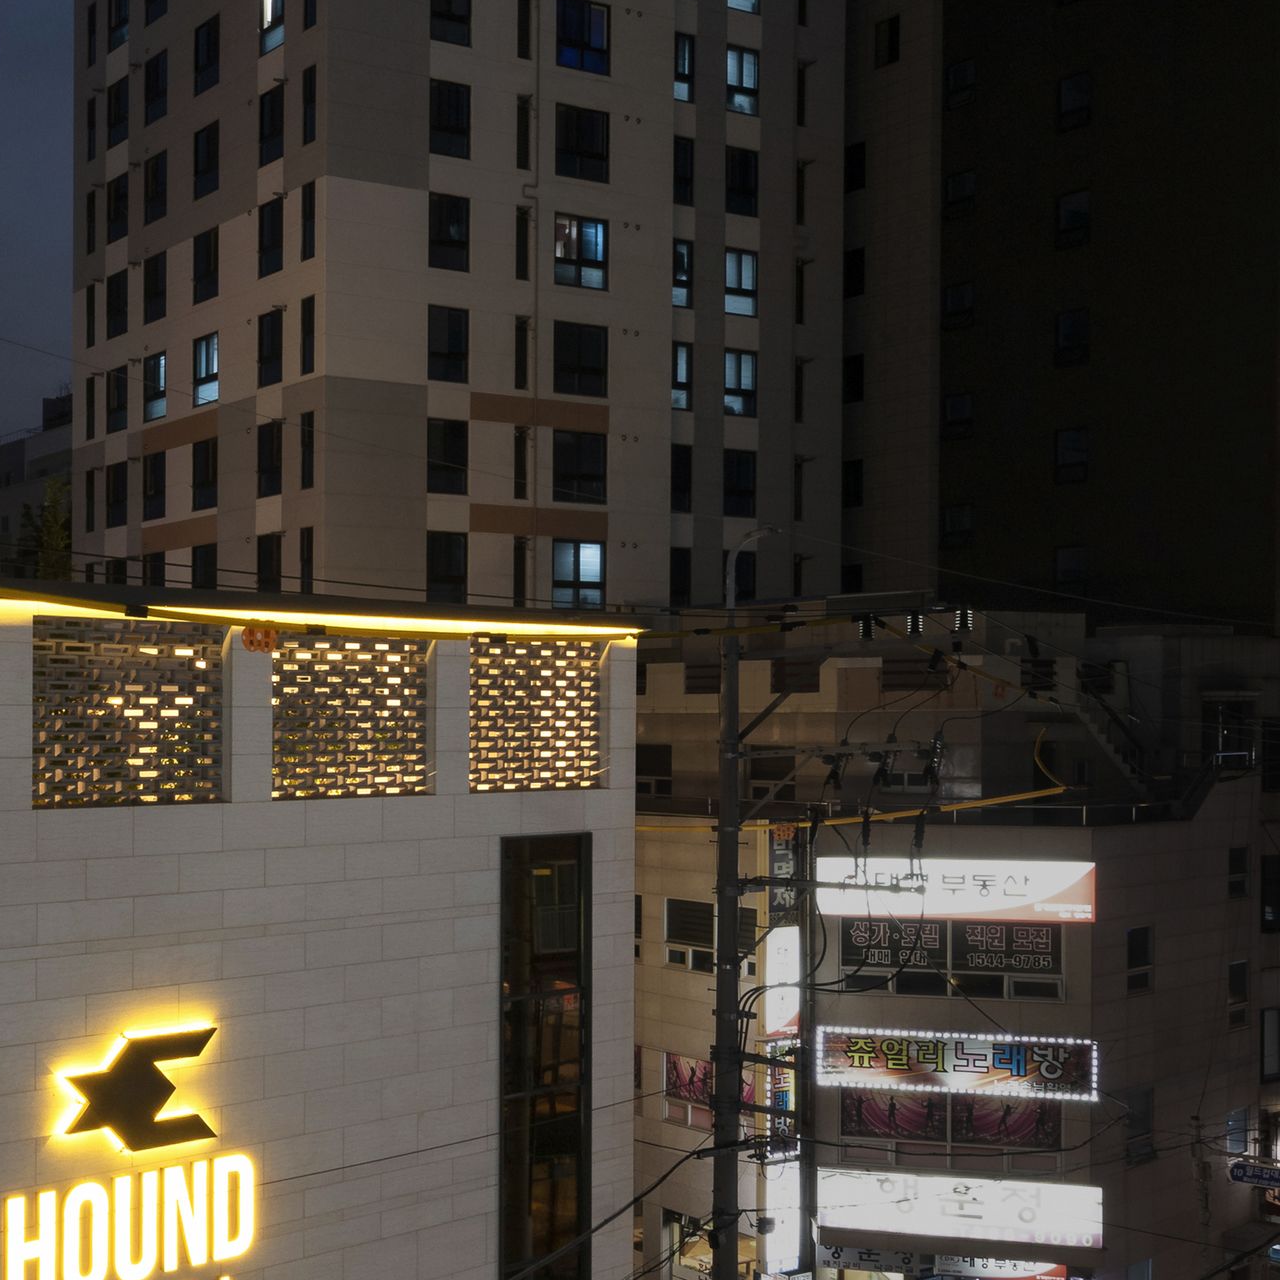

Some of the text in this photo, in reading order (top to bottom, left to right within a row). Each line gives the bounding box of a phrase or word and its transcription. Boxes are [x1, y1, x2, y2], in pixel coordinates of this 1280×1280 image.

[966, 925, 1006, 951] 직원
[1012, 927, 1052, 953] 모집
[967, 953, 1053, 969] 1544-9785
[1232, 1166, 1280, 1179] 10 월드컵대
